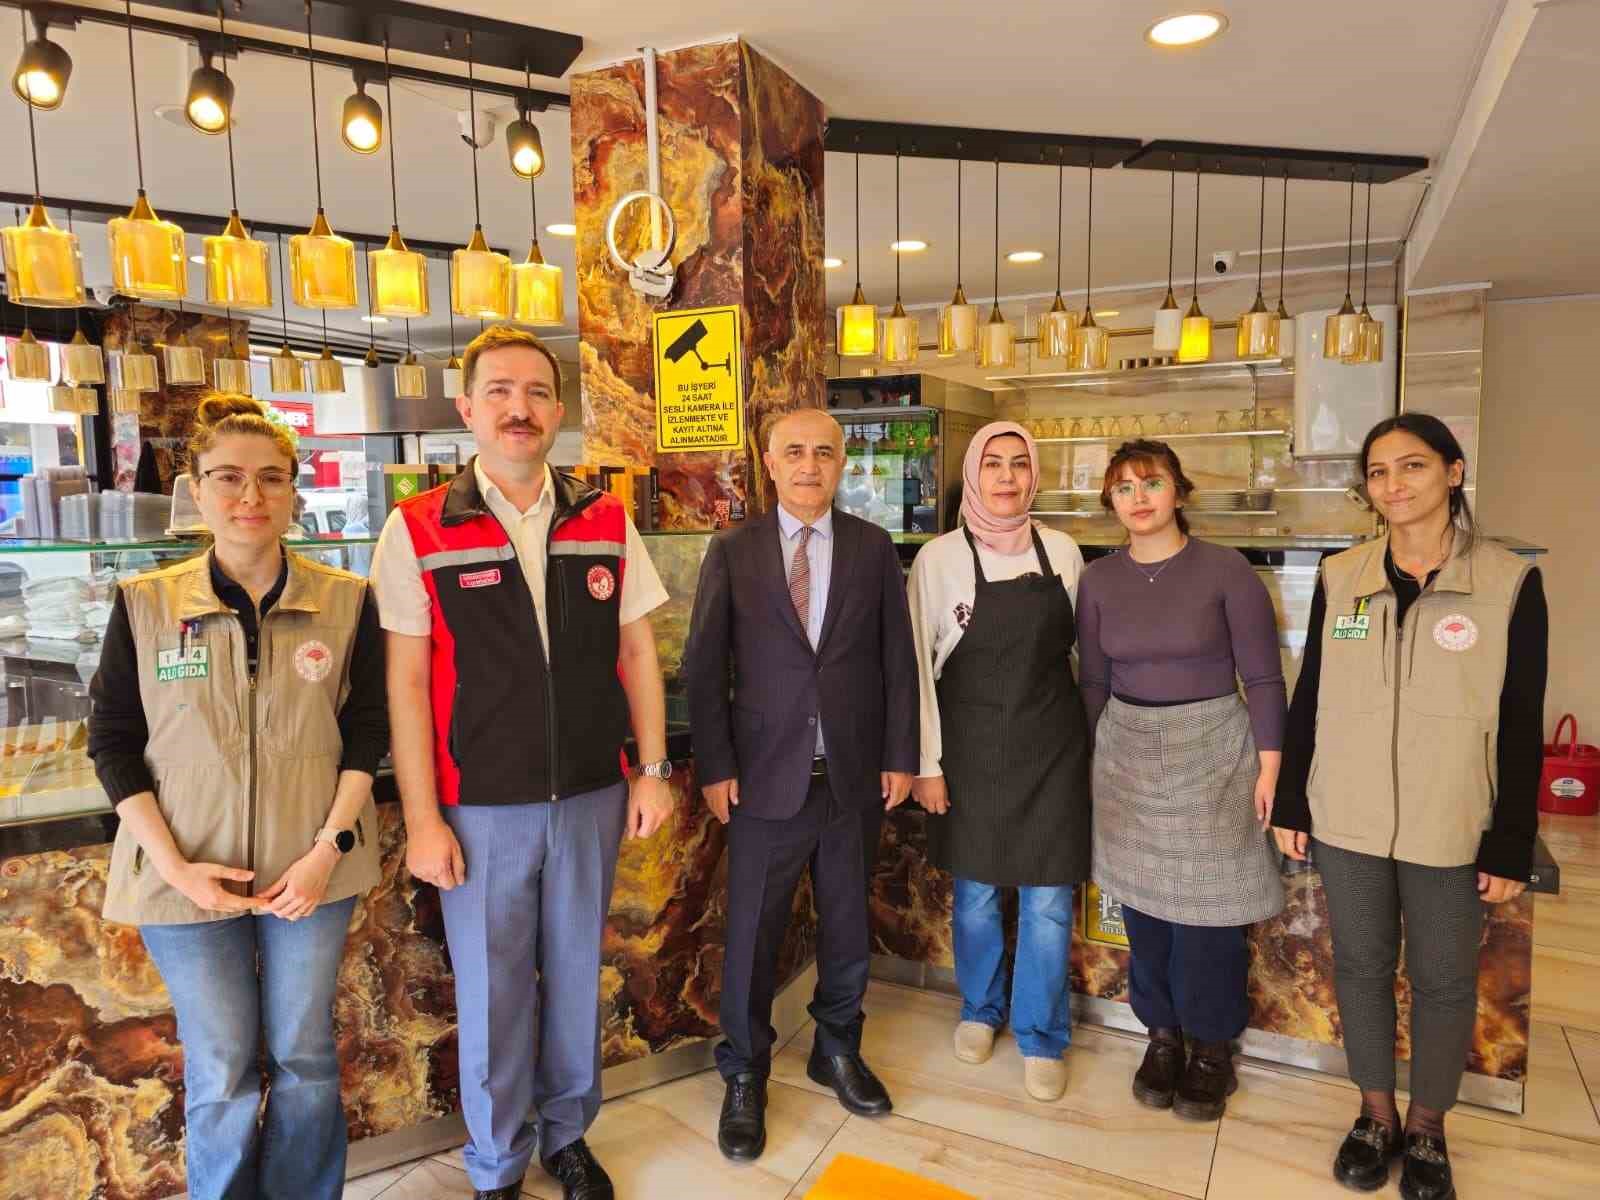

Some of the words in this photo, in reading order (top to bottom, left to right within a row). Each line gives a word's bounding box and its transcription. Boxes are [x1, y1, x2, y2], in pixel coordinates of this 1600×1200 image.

[692, 393, 712, 401] SAAT
[687, 403, 720, 412] KAMERA
[668, 414, 717, 423] İZLENMEKTE
[719, 413, 729, 421] VE
[673, 425, 694, 433] KAYIT
[696, 424, 725, 432] ALTINA
[670, 434, 728, 444] ALINMAKTADIR
[177, 665, 206, 678] GIDA
